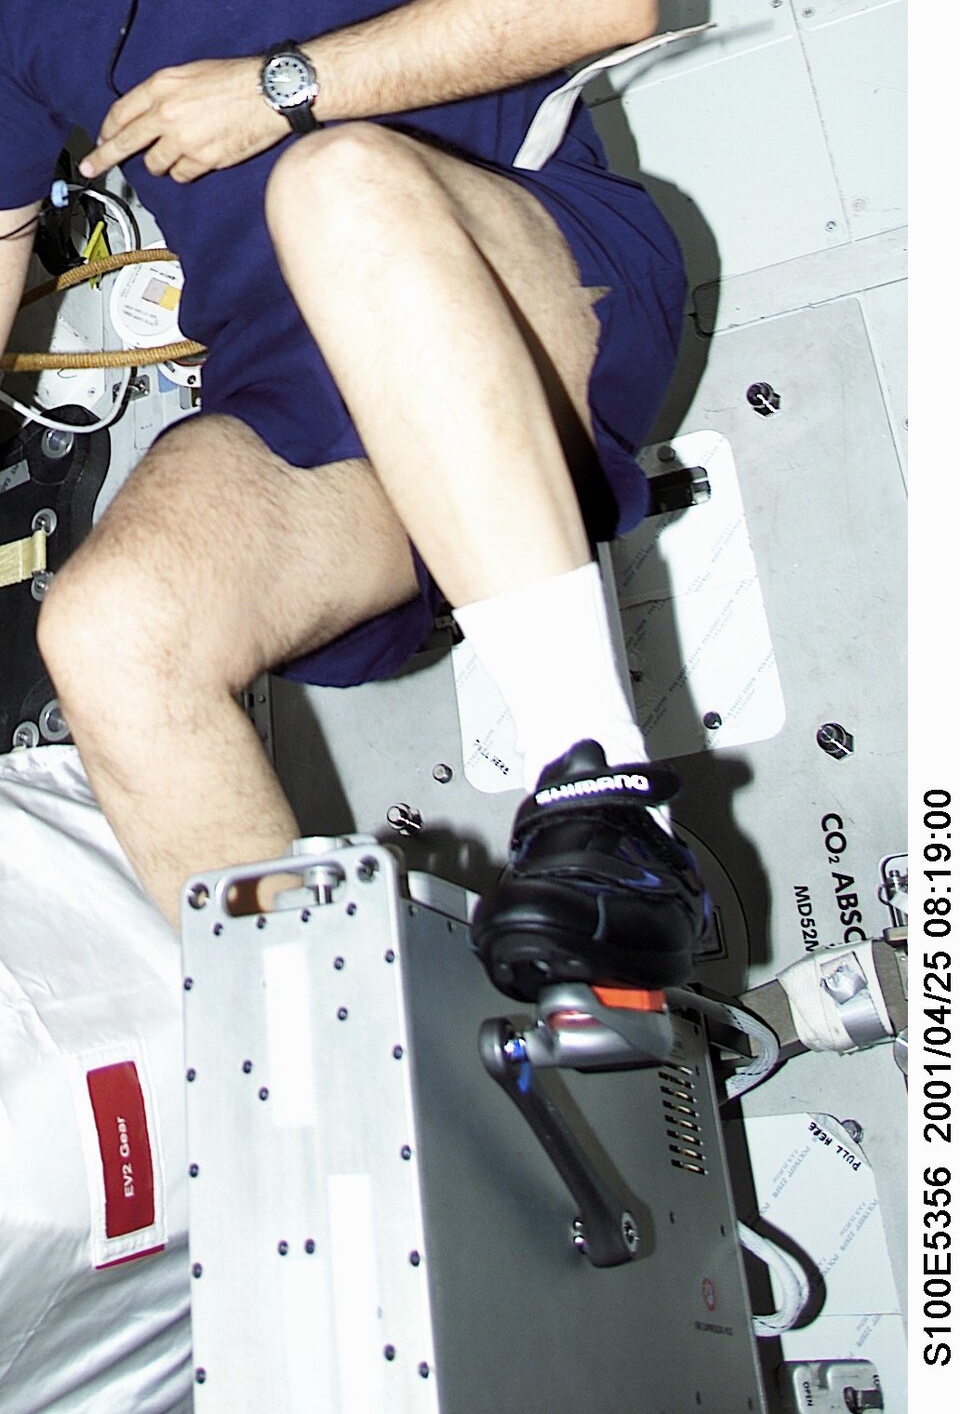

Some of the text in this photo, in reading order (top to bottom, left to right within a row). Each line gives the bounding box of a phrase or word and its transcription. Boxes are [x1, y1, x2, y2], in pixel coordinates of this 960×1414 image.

[116, 1116, 135, 1198] EV2 Gear
[808, 1122, 862, 1171] PULL HERE
